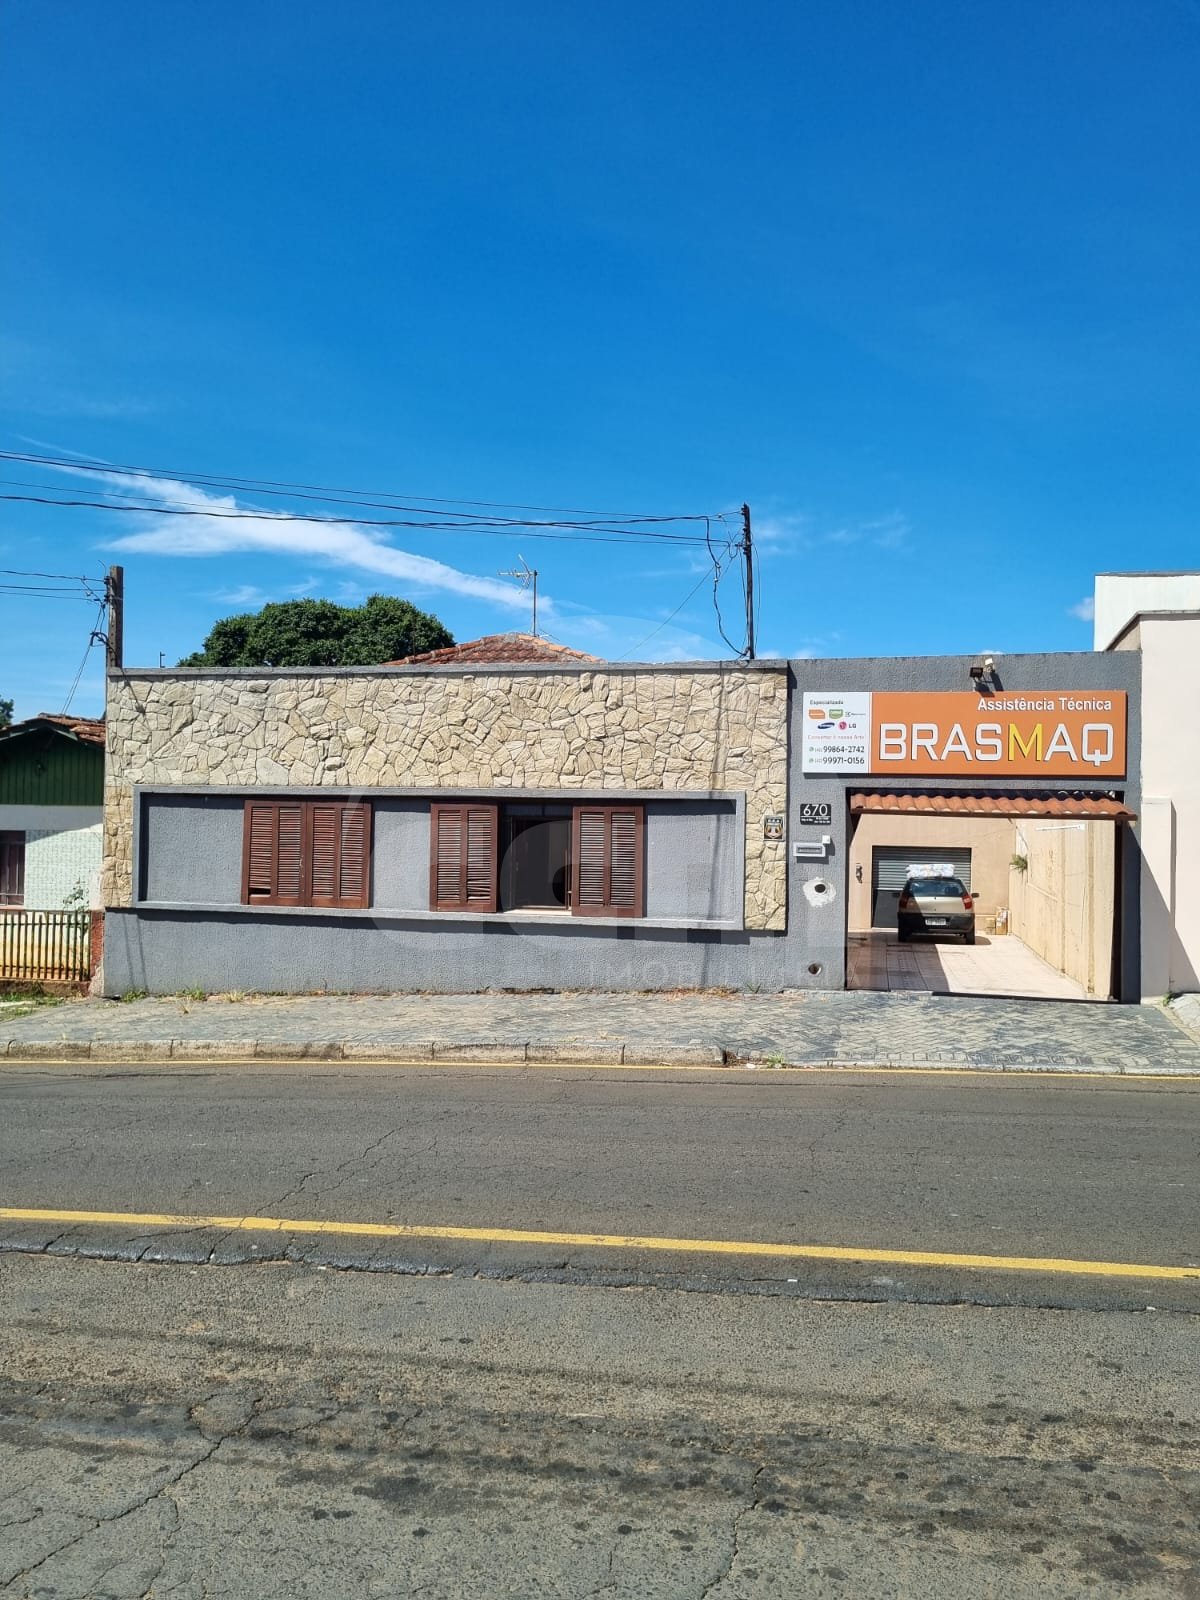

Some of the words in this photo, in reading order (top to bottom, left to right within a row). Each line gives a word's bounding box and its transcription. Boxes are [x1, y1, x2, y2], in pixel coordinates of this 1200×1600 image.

[977, 697, 1055, 711] Assistência
[1059, 697, 1112, 711] Técnica
[823, 745, 865, 753] 99864-2742
[879, 723, 1114, 766] BRASMAQ
[822, 757, 865, 765] 99971-0156
[803, 804, 828, 816] 670
